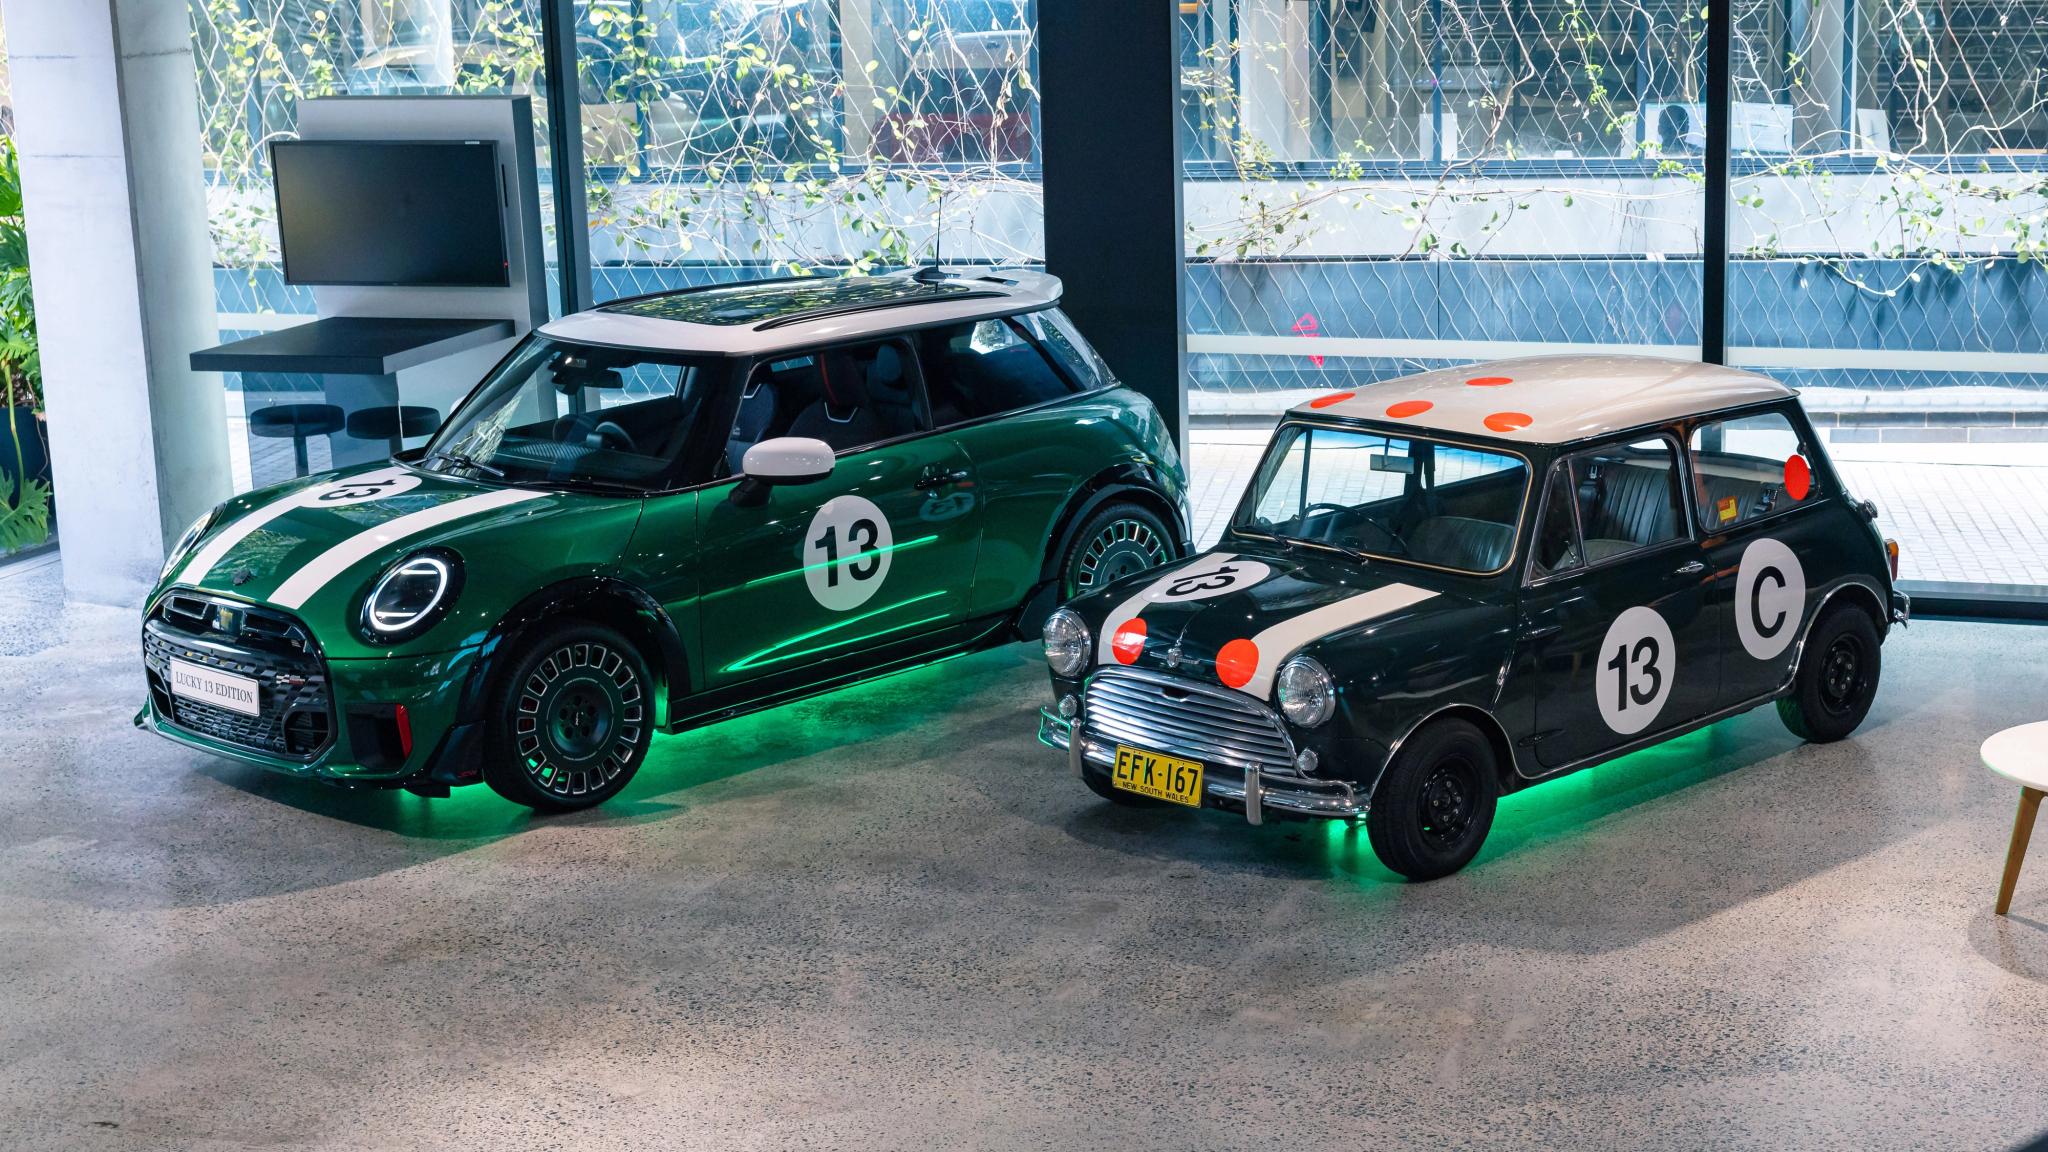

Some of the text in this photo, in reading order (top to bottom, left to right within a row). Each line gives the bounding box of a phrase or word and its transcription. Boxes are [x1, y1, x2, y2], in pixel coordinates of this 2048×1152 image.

[318, 479, 397, 501] 13
[815, 518, 881, 588] 13
[1165, 566, 1239, 596] 13
[1751, 565, 1787, 639] C
[176, 671, 253, 704] LUCKY 13 EDITION
[1608, 636, 1663, 712] 13
[1122, 781, 1190, 804] NEW SOUTH WALES
